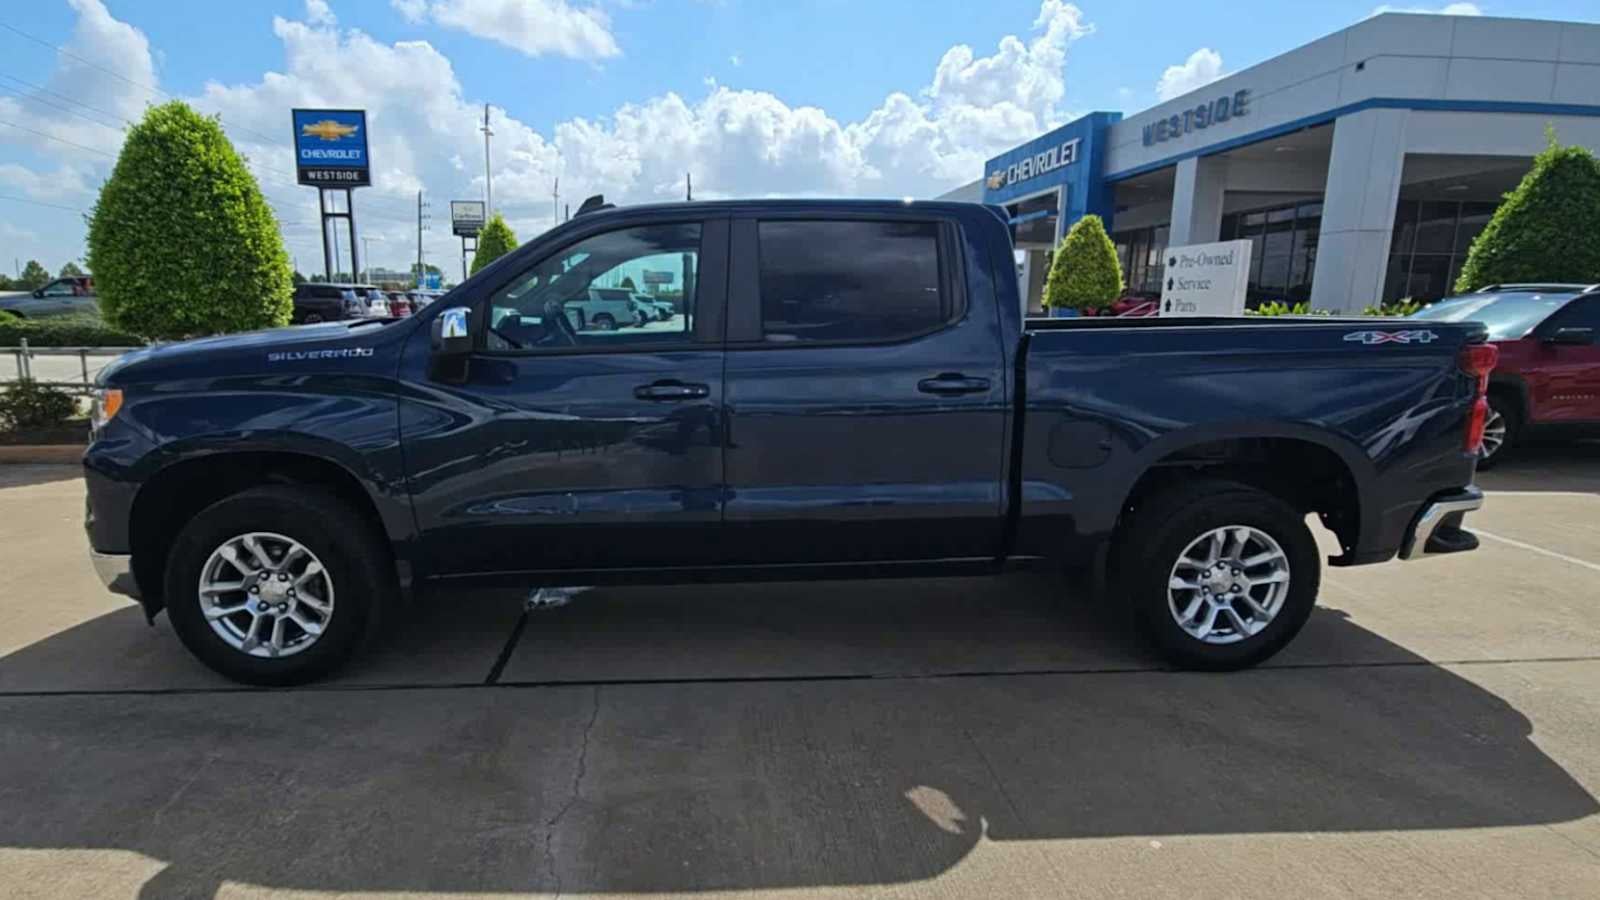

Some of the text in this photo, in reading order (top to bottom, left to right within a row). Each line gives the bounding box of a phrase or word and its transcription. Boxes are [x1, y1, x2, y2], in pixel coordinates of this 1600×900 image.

[1142, 90, 1250, 146] WESTSIDE
[301, 148, 361, 159] CHEVROLET
[1008, 137, 1081, 185] CHEVROLET
[307, 170, 360, 180] WESTSIDE
[1180, 249, 1234, 268] Pre-Owned
[1178, 276, 1213, 291] Service
[1175, 299, 1197, 313] Parts
[268, 347, 374, 361] SILVERADO
